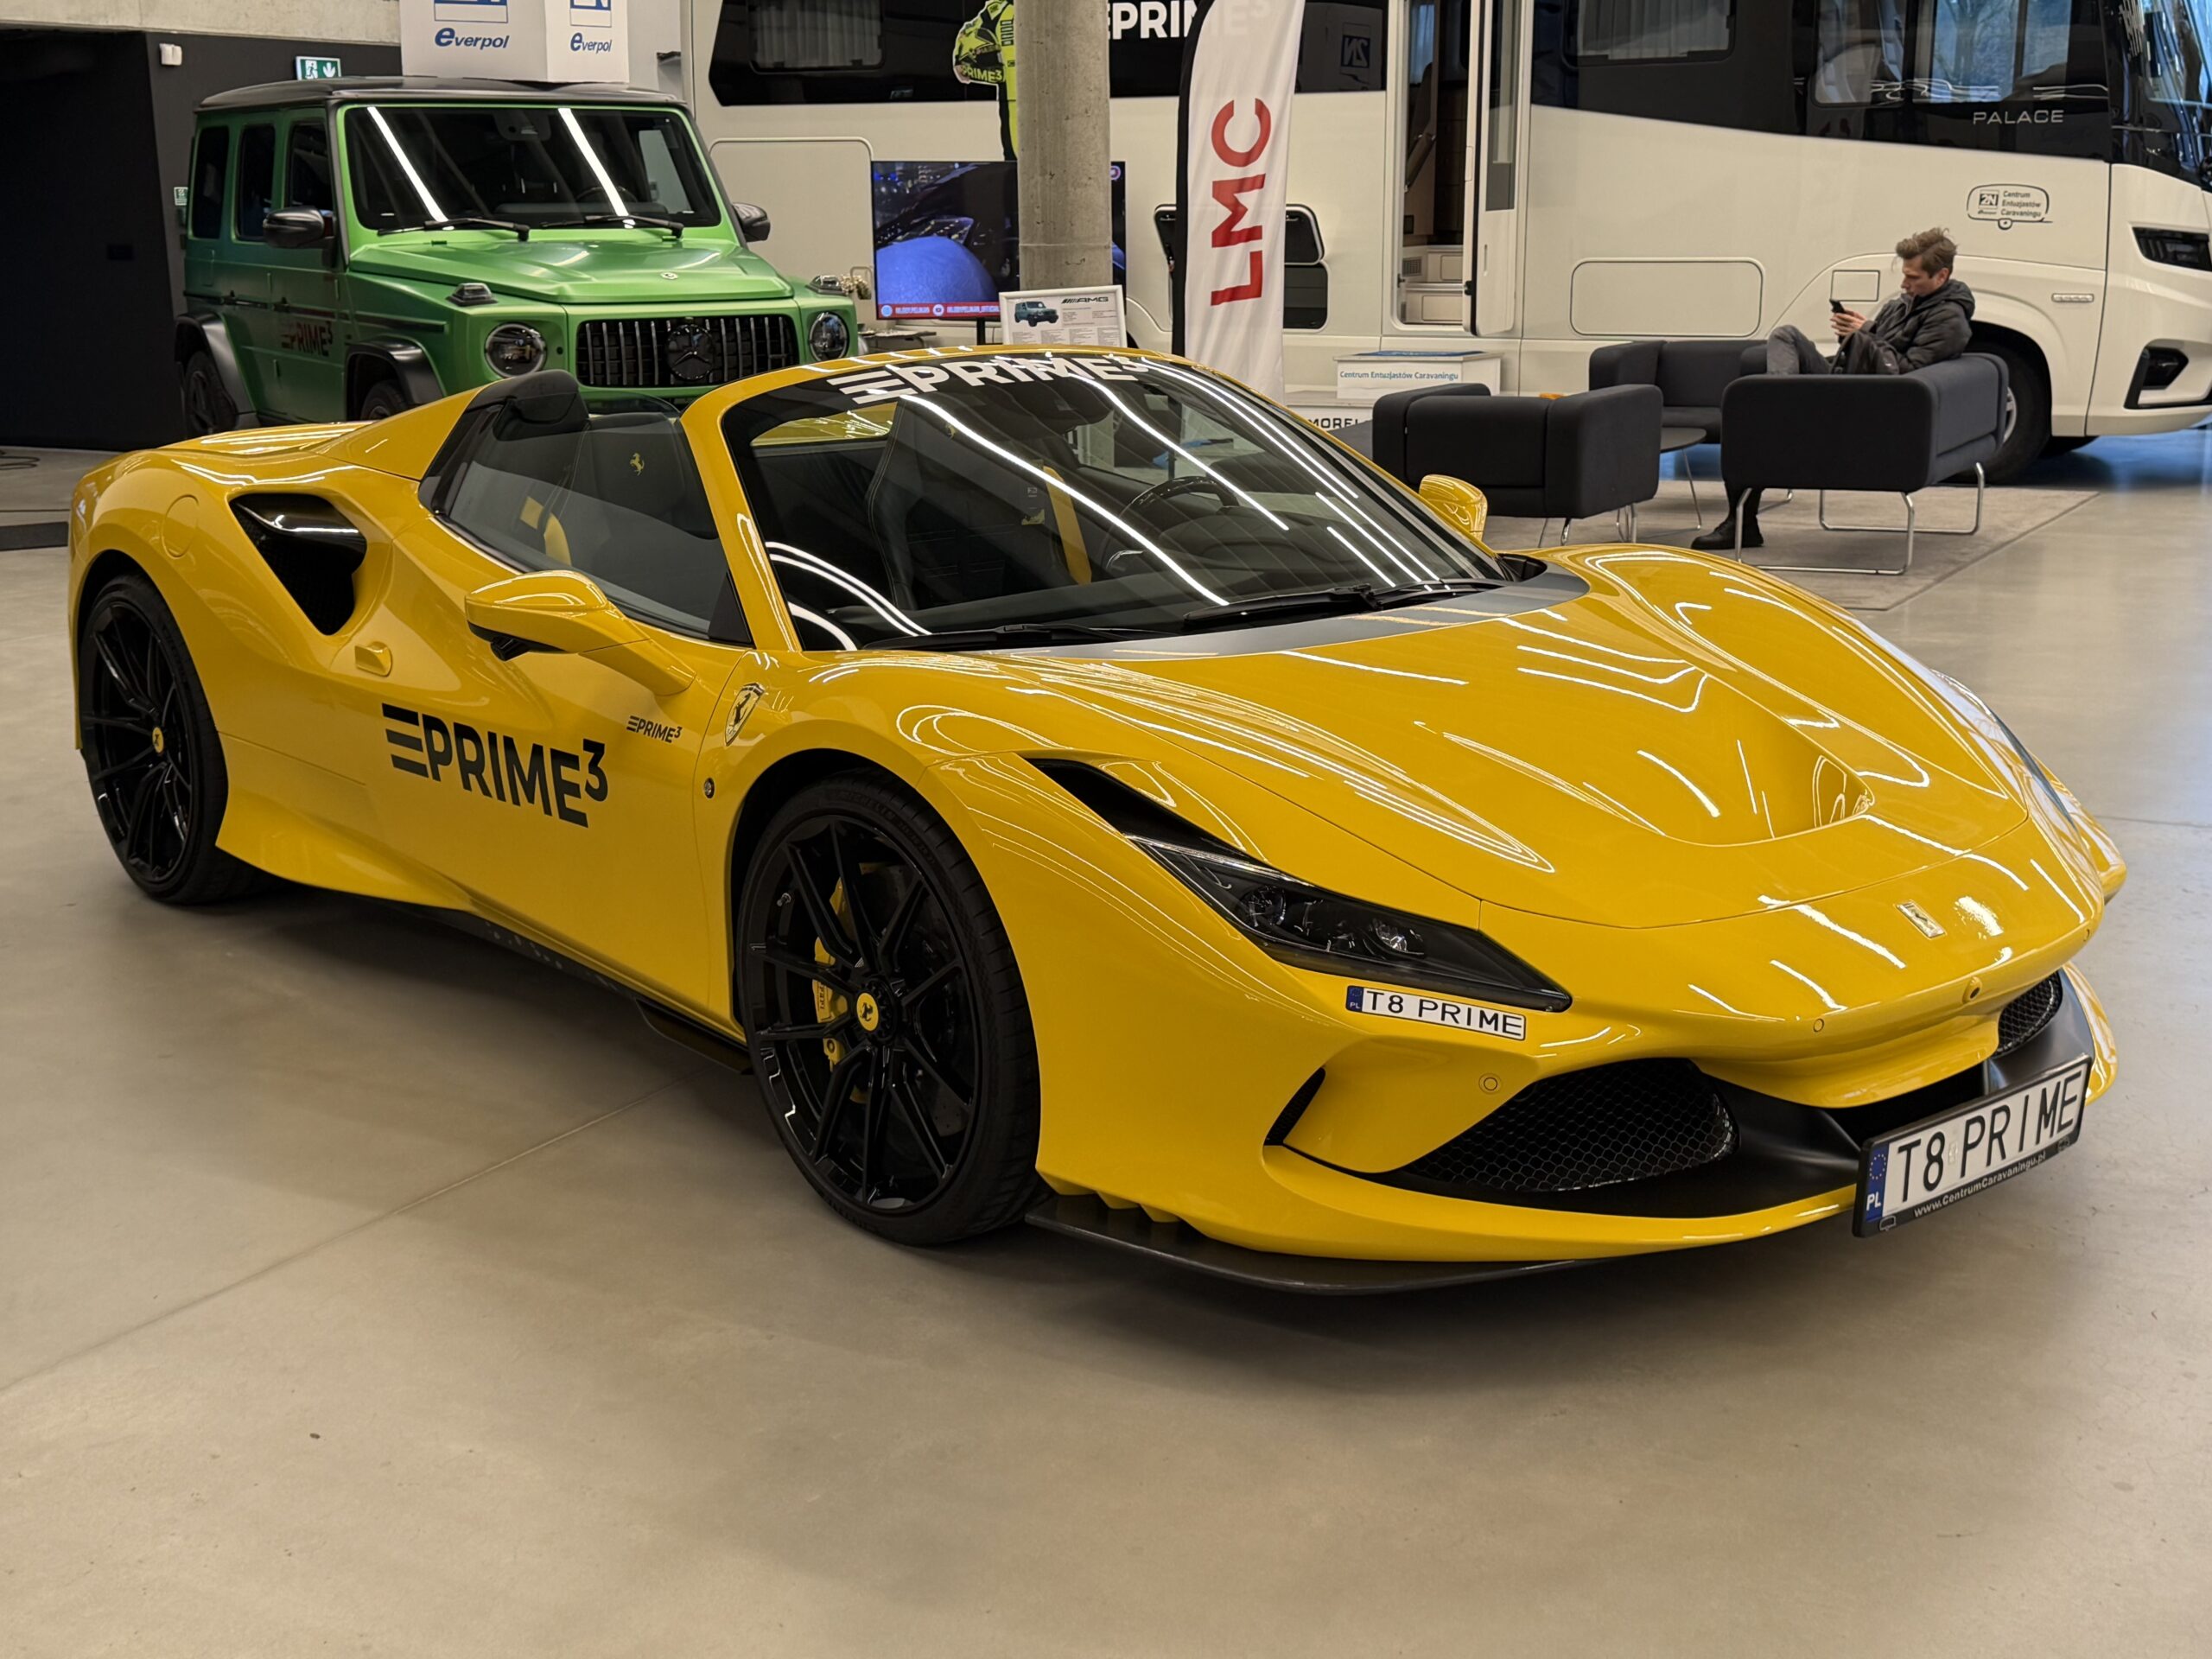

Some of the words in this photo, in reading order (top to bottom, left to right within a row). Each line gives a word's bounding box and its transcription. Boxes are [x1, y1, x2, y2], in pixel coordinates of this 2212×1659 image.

[434, 27, 511, 50] everpol
[569, 32, 613, 54] everpol
[1972, 109, 2064, 125] PALACE
[1211, 98, 1272, 307] LMC
[2001, 199, 2041, 209] Entuzjastów
[2002, 190, 2031, 199] Centrum
[1999, 208, 2042, 219] Caravaningu
[1339, 371, 1370, 379] Centrum
[1370, 371, 1414, 381] Entuzjastów
[1414, 372, 1459, 382] Caravaningu
[1366, 989, 1404, 1014] T8
[1417, 998, 1523, 1037] PRIME
[1897, 1131, 1946, 1202] T8
[1959, 1070, 2082, 1179] PRIME
[1913, 1152, 2046, 1217] www.CentrumCaravaningu.pl
[1866, 1191, 1882, 1211] PL
